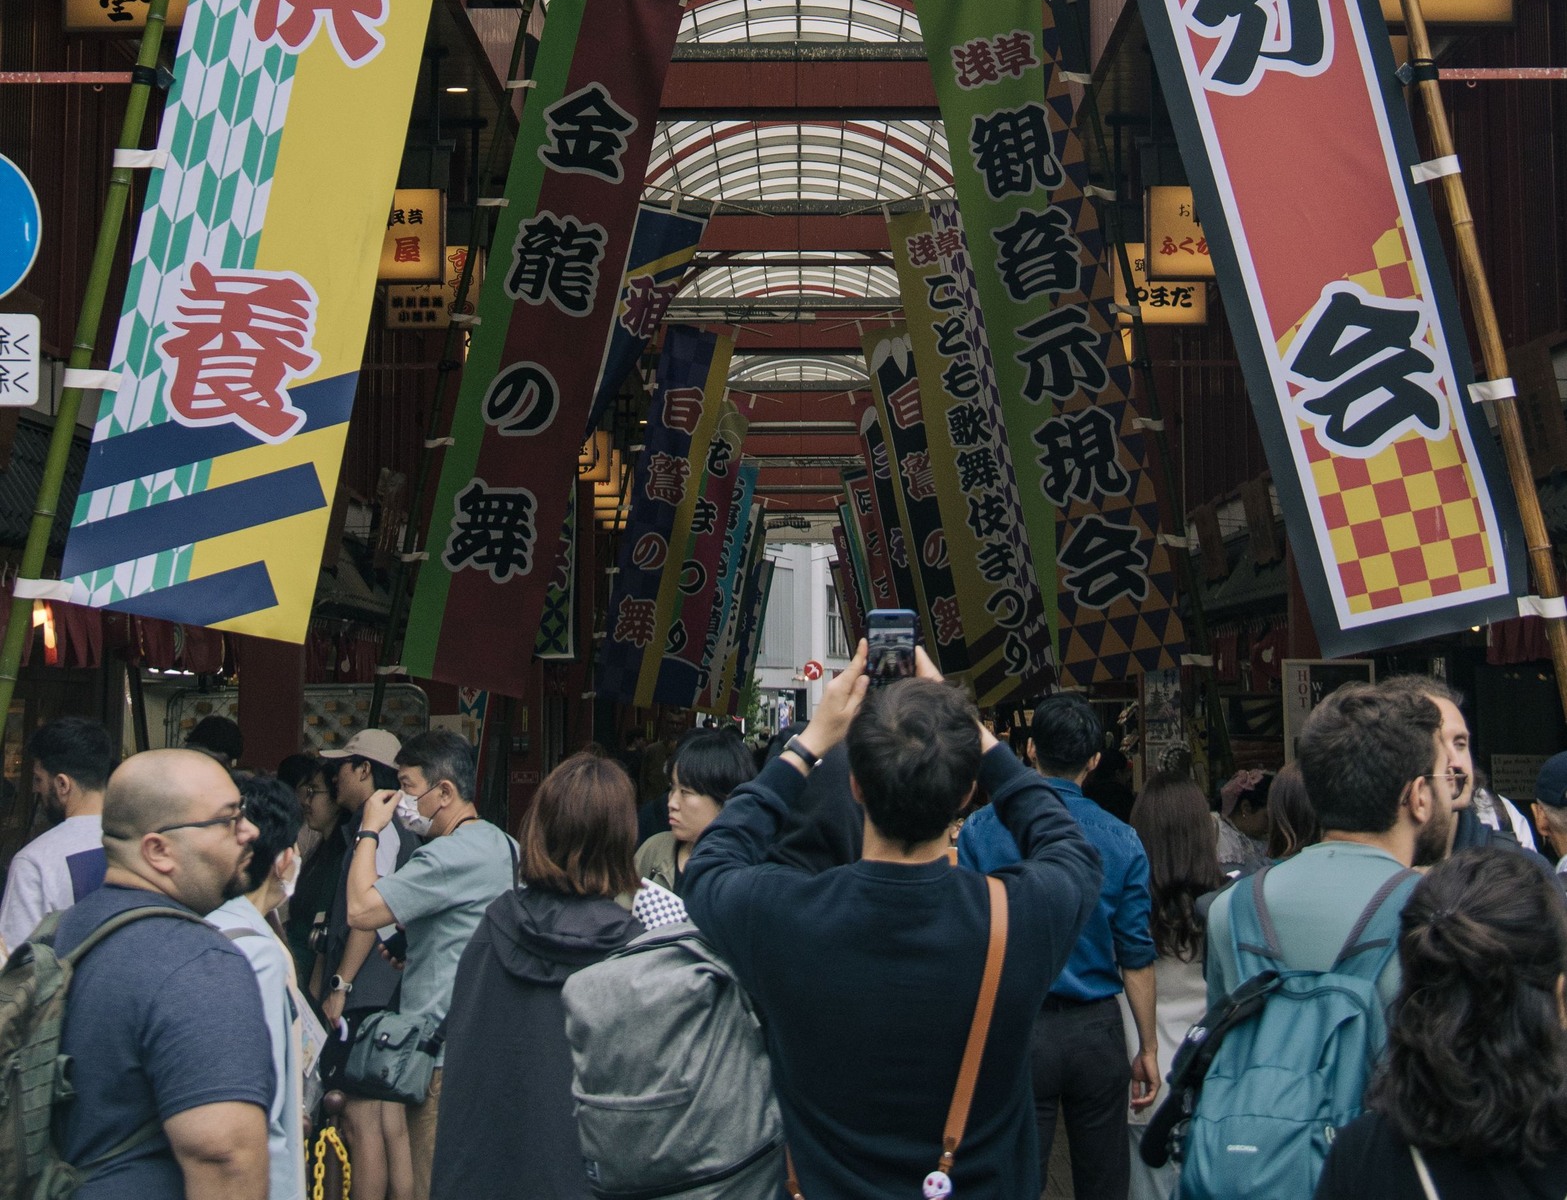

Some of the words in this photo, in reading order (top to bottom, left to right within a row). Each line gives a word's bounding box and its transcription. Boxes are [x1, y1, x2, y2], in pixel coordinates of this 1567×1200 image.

[953, 32, 1037, 87] 浅草
[394, 235, 421, 263] 屋
[446, 85, 633, 578] 金龍の舞
[908, 229, 962, 265] 浅草
[973, 108, 1149, 607] 観音示現会
[926, 274, 1029, 674] こども歌舞伎まつり
